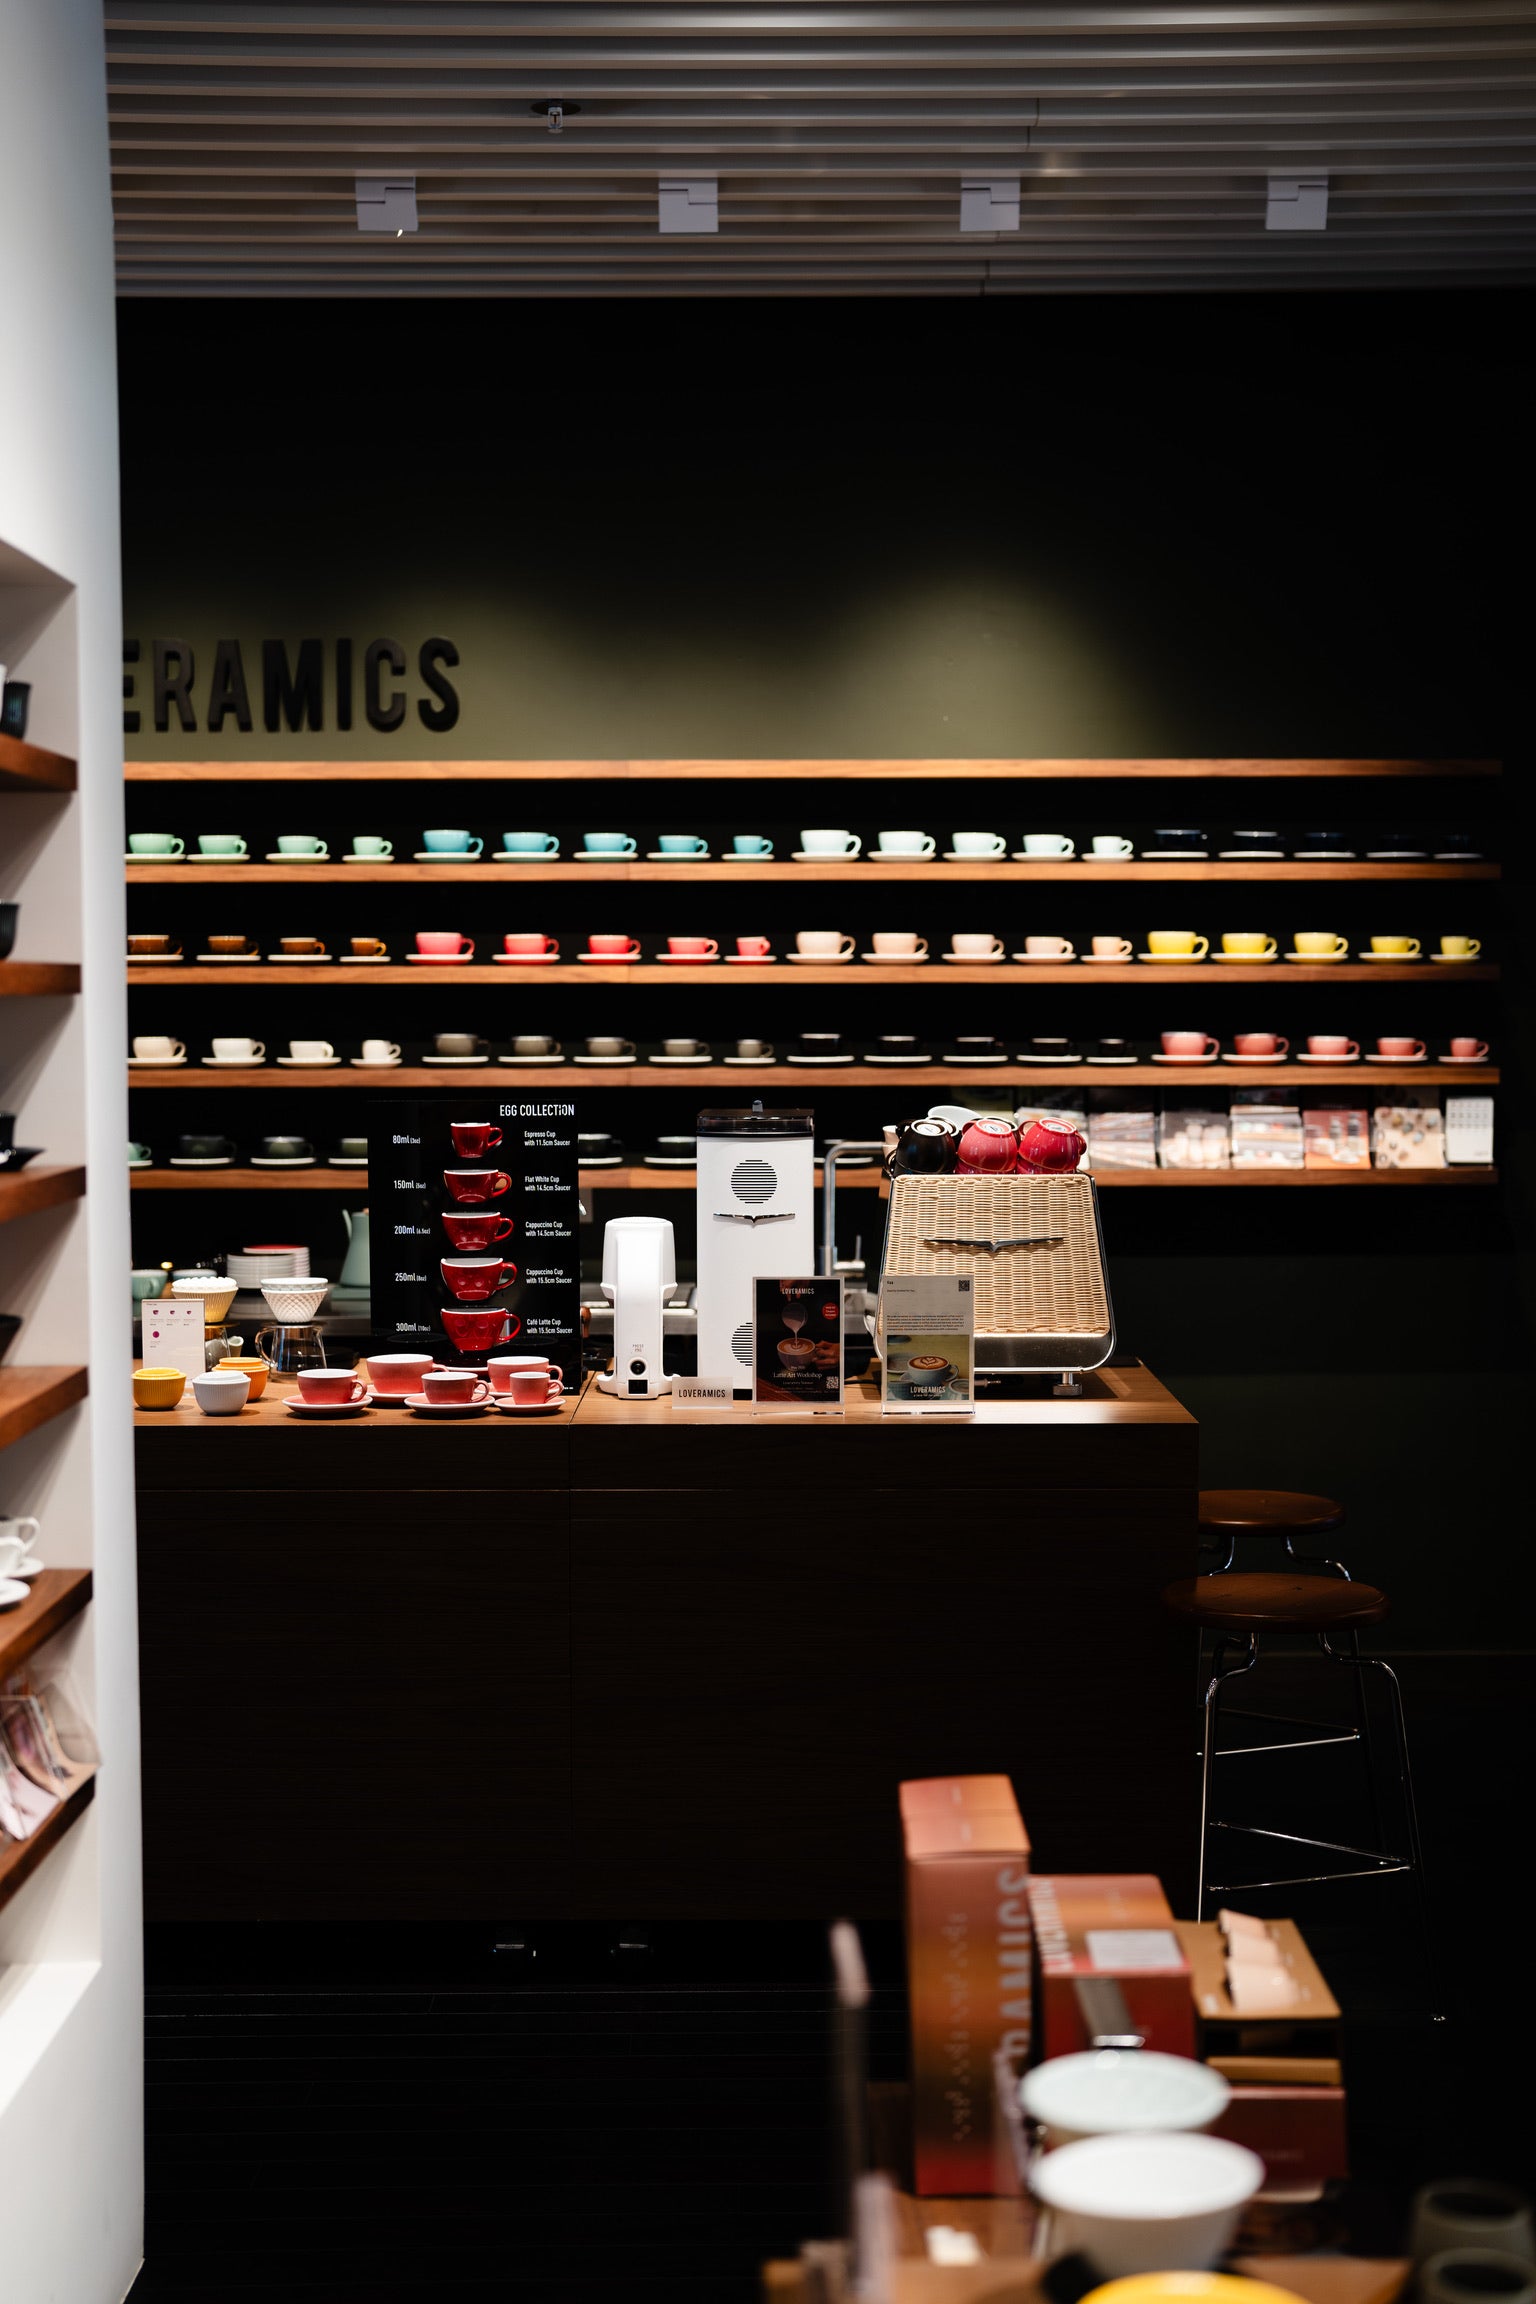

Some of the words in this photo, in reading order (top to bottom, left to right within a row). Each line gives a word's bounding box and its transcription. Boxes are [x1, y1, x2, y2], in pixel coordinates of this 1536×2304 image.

[500, 1104, 517, 1116] EGG
[520, 1104, 575, 1116] COLLECTION
[393, 1135, 409, 1144] 80ml
[393, 1180, 414, 1189] 150ml
[394, 1225, 415, 1234] 200ml
[525, 1221, 553, 1229] Cappuccino
[553, 1221, 563, 1229] Cup
[395, 1272, 416, 1281] 250ml
[526, 1268, 553, 1276] Cappuccino
[554, 1268, 564, 1276] Cup
[396, 1322, 416, 1331] 300ml
[526, 1318, 538, 1326] Café
[538, 1318, 551, 1326] Latte
[552, 1318, 562, 1326] Cup
[678, 1389, 726, 1398] LOVERAMICS
[910, 1386, 946, 1394] LOVERAMICS
